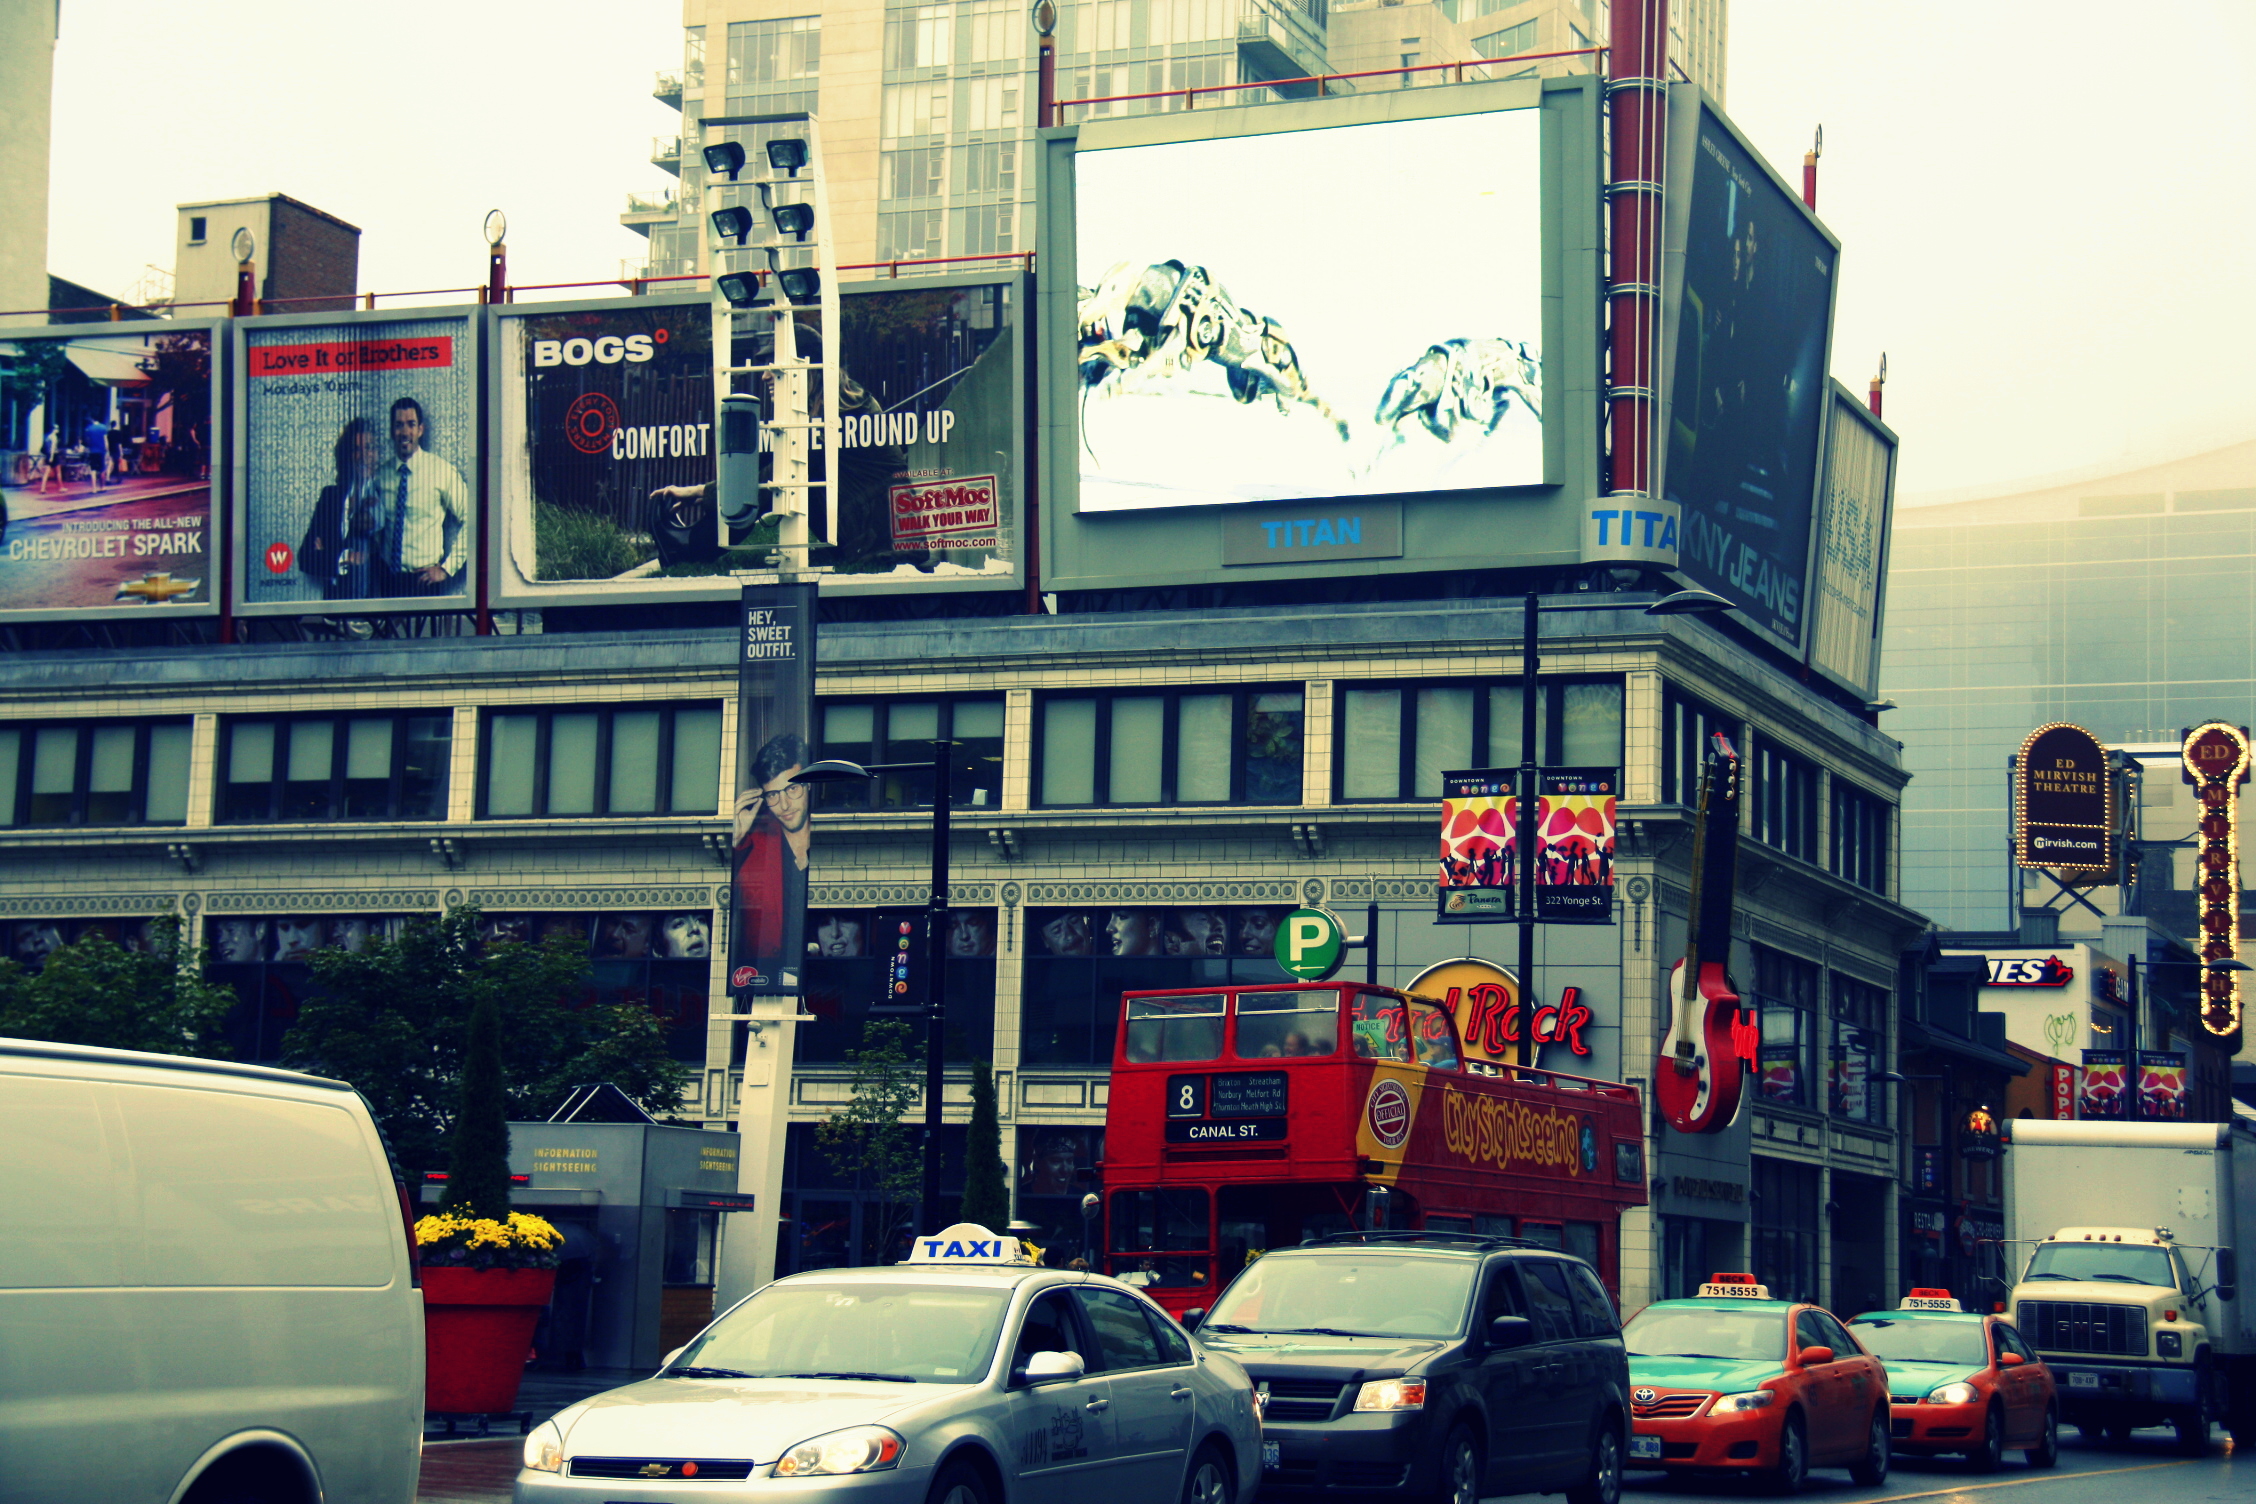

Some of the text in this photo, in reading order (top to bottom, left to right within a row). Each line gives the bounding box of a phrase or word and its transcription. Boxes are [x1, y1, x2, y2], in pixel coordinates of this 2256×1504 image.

[534, 334, 654, 367] BOGS
[262, 352, 310, 370] Love
[315, 349, 329, 367] It
[335, 351, 355, 365] or
[262, 382, 320, 397] Mondays
[926, 410, 955, 443] UP
[612, 423, 710, 460] COMFORT
[893, 468, 954, 478] AVAILABLE AT:
[896, 486, 991, 514] SoftMoc
[62, 516, 202, 534] INTRODUCING THE ALL-NEW
[898, 508, 990, 532] WALK YOUR WAY
[1260, 516, 1361, 548] TITAN
[9, 531, 202, 561] CHEVROLET SPARK
[893, 538, 996, 551] www.softmoc.com
[270, 550, 288, 566] W
[1681, 503, 1732, 577] KNY
[1729, 542, 1799, 624] JEANS
[748, 610, 776, 626] HEY,
[748, 626, 791, 642] SWEET
[747, 642, 796, 658] OUTFIT.
[2199, 744, 2229, 760] ED
[2056, 758, 2075, 769] ED
[2033, 769, 2097, 782] MIRVISH
[2033, 782, 2096, 794] THEATRE
[2033, 836, 2097, 849] mirvish.com
[1545, 895, 1603, 907] 322 Yonge St.
[1289, 916, 1330, 961] P
[1355, 1022, 1380, 1031] NOTICE
[1464, 983, 1592, 1056] Rock
[1217, 1077, 1281, 1087] Brixton Streatham
[1179, 1084, 1194, 1110] 8
[1218, 1088, 1281, 1101] Norbury Melfort Rd
[1260, 1101, 1273, 1112] High
[1376, 1104, 1404, 1121] OFFICIAL
[1189, 1124, 1258, 1138] CANAL ST.
[534, 1148, 597, 1158] INFORMATION
[700, 1147, 736, 1158] INFORMATION
[1962, 1146, 1995, 1155] BREWERS
[533, 1162, 597, 1173] SIGHTSEEING
[699, 1160, 735, 1172] SIGHTSEEING
[923, 1241, 1002, 1257] TAXI
[1718, 1275, 1746, 1284] BECK
[1706, 1285, 1758, 1297] 751-5555
[1918, 1289, 1940, 1297] BECK
[1908, 1299, 1951, 1309] 751-5555
[2057, 1320, 2106, 1333] GMC
